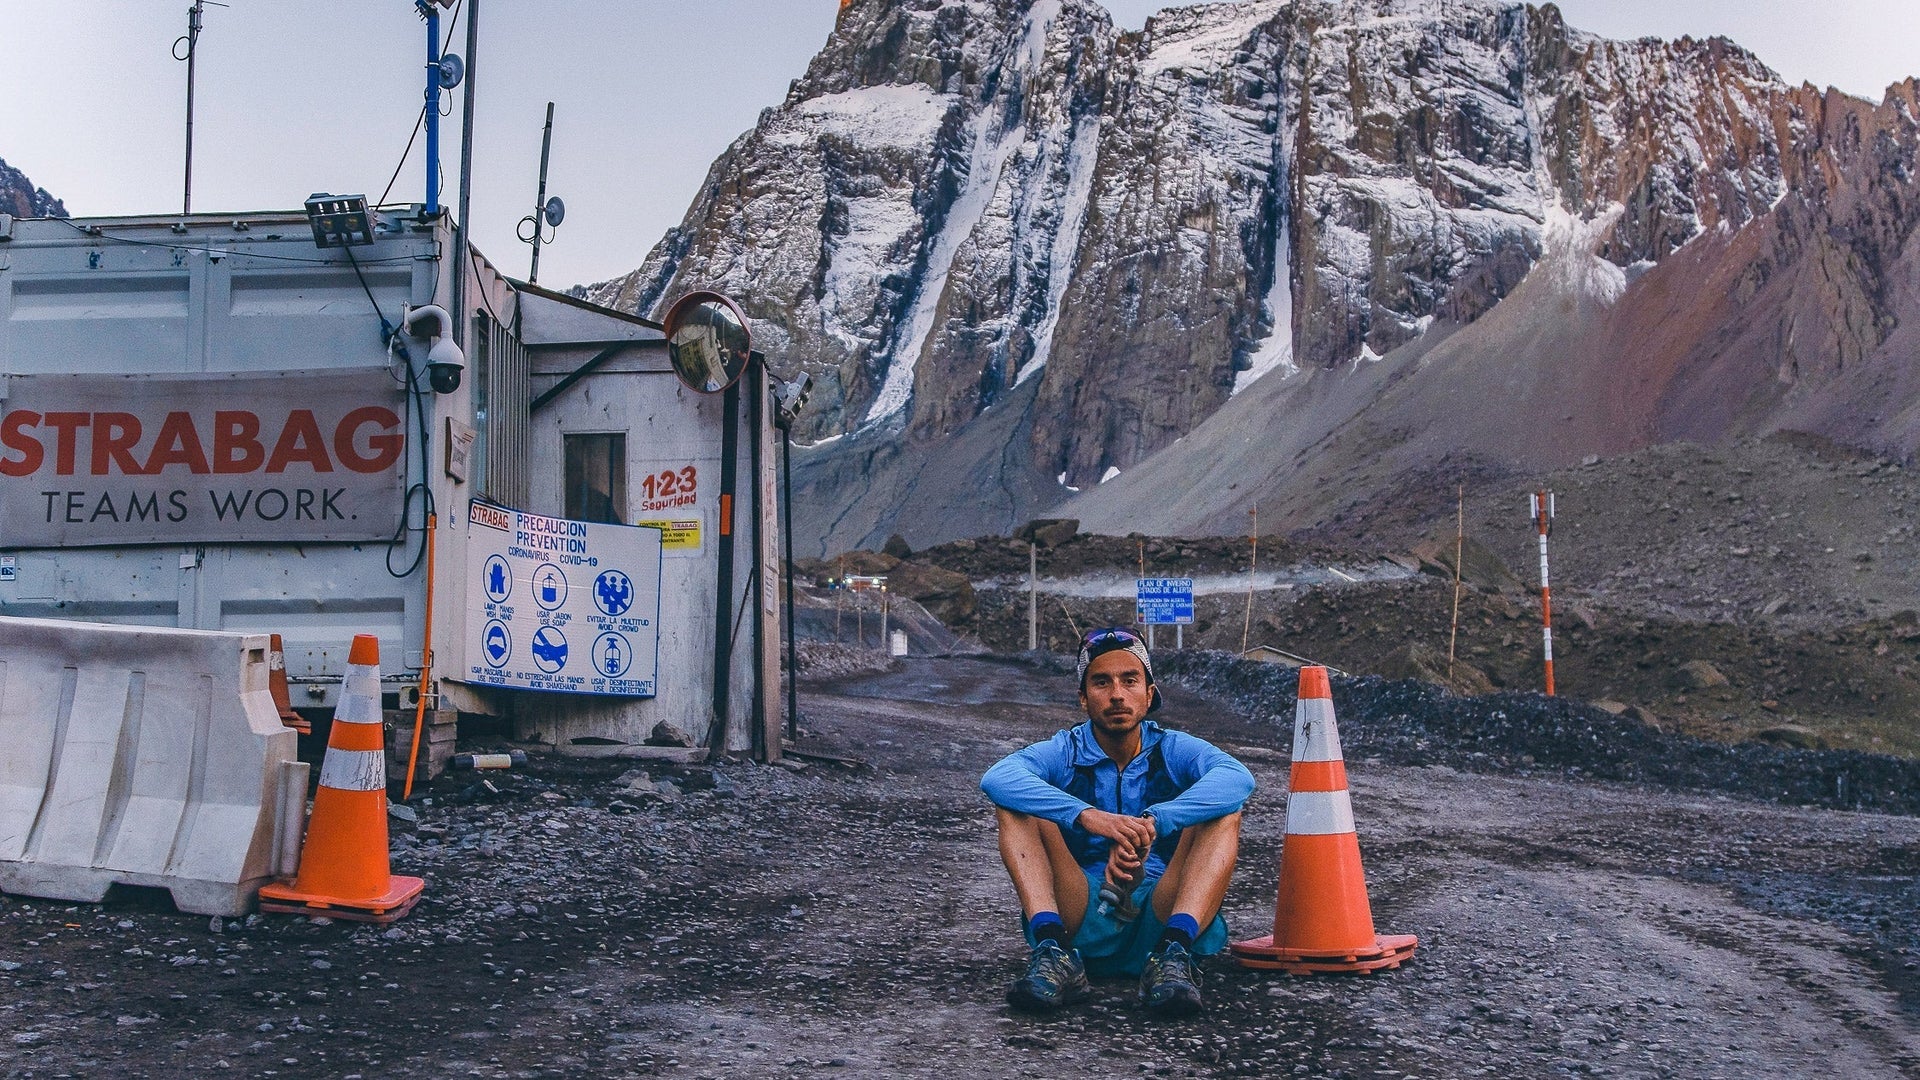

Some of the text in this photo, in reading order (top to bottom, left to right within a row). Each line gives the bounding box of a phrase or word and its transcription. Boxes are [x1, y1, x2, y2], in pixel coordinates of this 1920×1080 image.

[0, 405, 405, 477] STRABAG
[40, 487, 358, 523] TEAMS WORK.
[642, 492, 697, 511] Seguridad
[471, 505, 510, 529] STRABAG
[516, 513, 587, 537] PRECAUCION
[516, 530, 587, 553] PREVENTION
[508, 546, 598, 567] CORONAVIRUS COVID-19
[499, 604, 515, 614] MANOS
[500, 612, 513, 621] HAND
[554, 612, 572, 621] JABON
[586, 615, 606, 623] EVITAR
[620, 618, 649, 626] MULTITUD
[552, 619, 567, 627] SOAP
[618, 624, 639, 632] CROWD
[477, 674, 486, 682] USE
[484, 668, 512, 678] MASCARILLAS
[525, 673, 553, 682] ESTRECHAR
[554, 675, 565, 683] LAS
[567, 676, 585, 684] MANOS
[609, 679, 652, 687] DESINFECTANTE
[529, 680, 577, 690] AVOID SHAKEHAND
[609, 686, 648, 694] DESINFECTION
